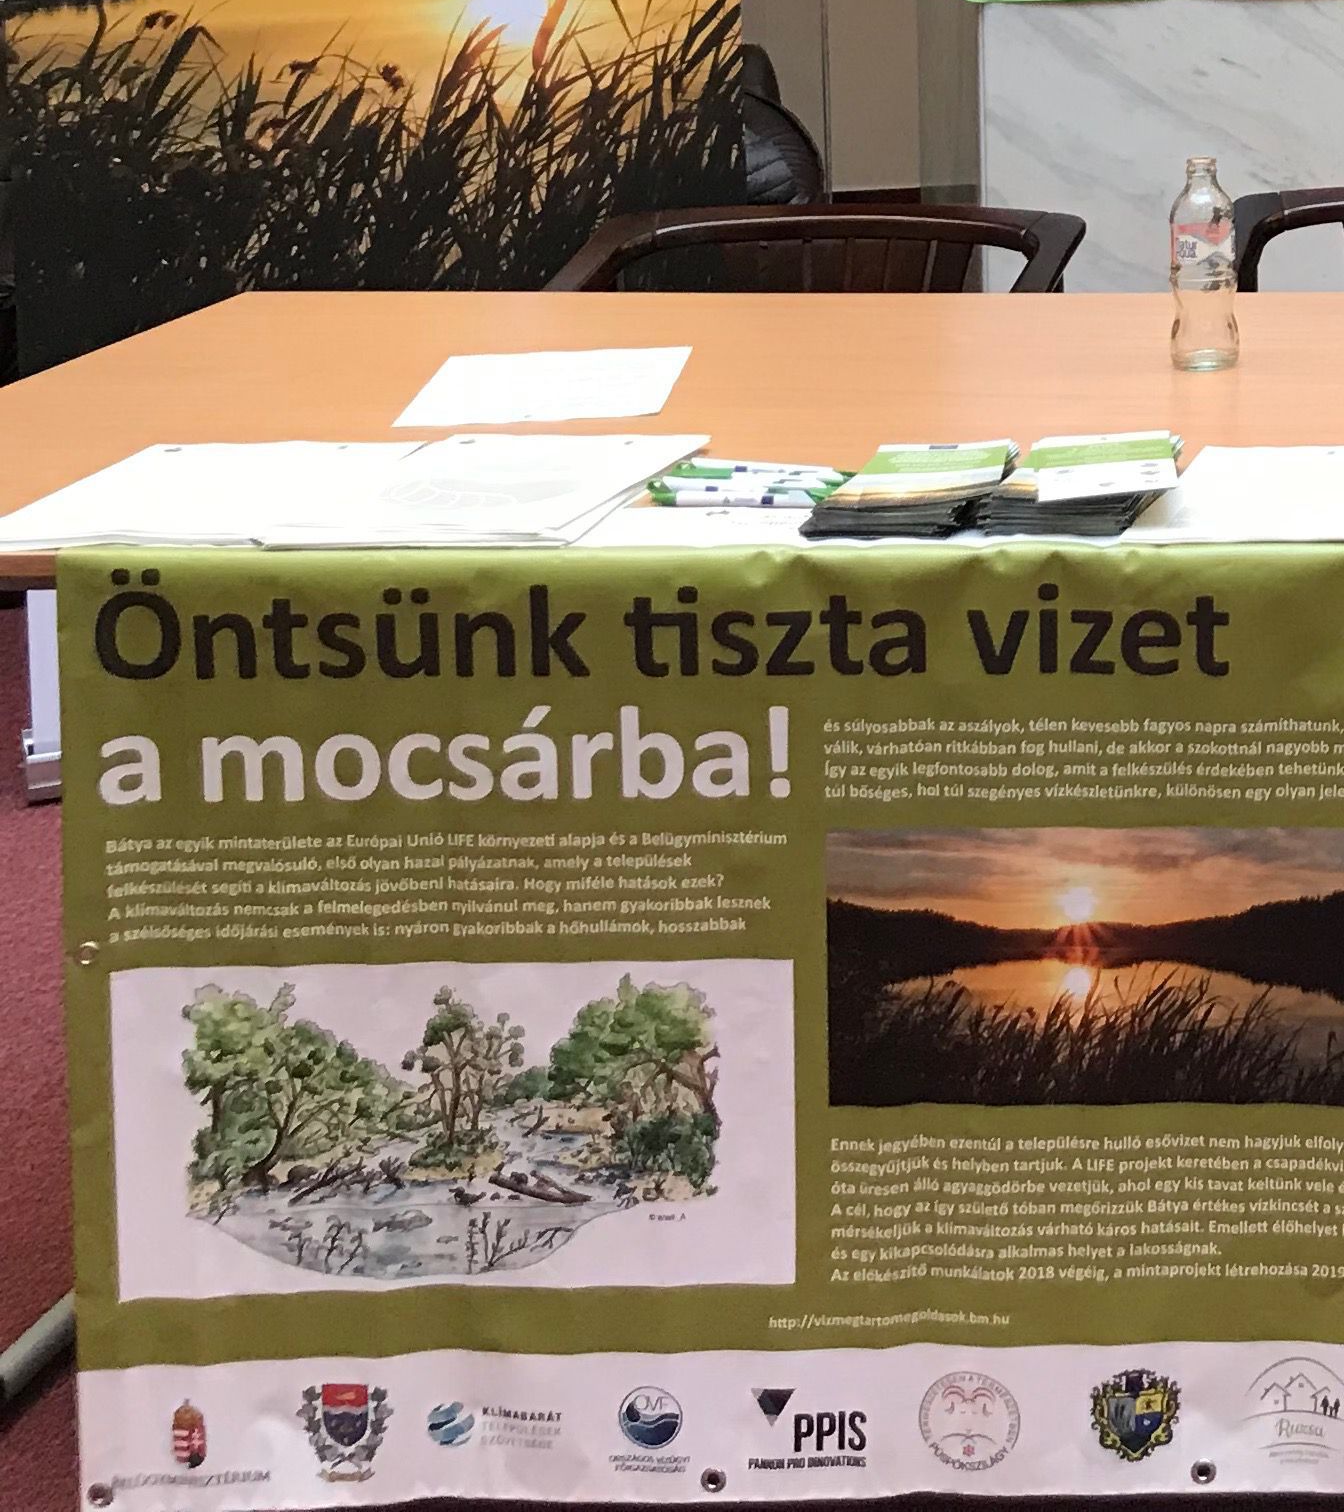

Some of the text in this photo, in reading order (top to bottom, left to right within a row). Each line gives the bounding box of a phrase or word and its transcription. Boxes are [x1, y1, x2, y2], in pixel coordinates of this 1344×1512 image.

[95, 568, 1229, 679] Öntsünk tiszta vizet
[824, 719, 840, 733] és
[844, 718, 935, 735] súlyosabbak
[940, 721, 954, 732] az
[958, 719, 1024, 736] aszályok,
[1029, 717, 1067, 731] télen
[1072, 718, 1139, 733] kevesebb
[1143, 719, 1191, 735] fagyos
[1195, 722, 1236, 736] napra
[1241, 718, 1344, 734] számíthatunk,
[99, 705, 790, 804] a mocsárba!
[824, 740, 863, 755] válik,
[867, 741, 942, 755] várhatóan
[946, 740, 1016, 755] ritkábban
[1021, 740, 1044, 757] fog
[1049, 740, 1102, 757] hullani,
[1106, 741, 1124, 755] de
[1130, 740, 1171, 754] akkor
[1176, 743, 1183, 754] a
[1188, 742, 1261, 756] szokottnál
[1267, 741, 1329, 756] nagyobb
[825, 760, 846, 779] Így
[851, 766, 866, 776] az
[870, 762, 908, 780] egyik
[913, 761, 1007, 777] legfontosabb
[1012, 762, 1059, 779] dolog,
[1063, 763, 1096, 776] amit
[1100, 767, 1108, 777] a
[1112, 762, 1192, 777] felkészülés
[1197, 763, 1274, 777] érdekében
[825, 784, 845, 798] túl
[850, 785, 912, 802] bőséges,
[917, 783, 939, 797] hol
[944, 784, 963, 797] túl
[968, 786, 1040, 802] szegényes
[1045, 784, 1161, 799] vízkészletünkre,
[1167, 784, 1241, 799] különösen
[1245, 788, 1272, 802] egy
[1276, 784, 1315, 800] olyan
[794, 1411, 866, 1452] PPIS
